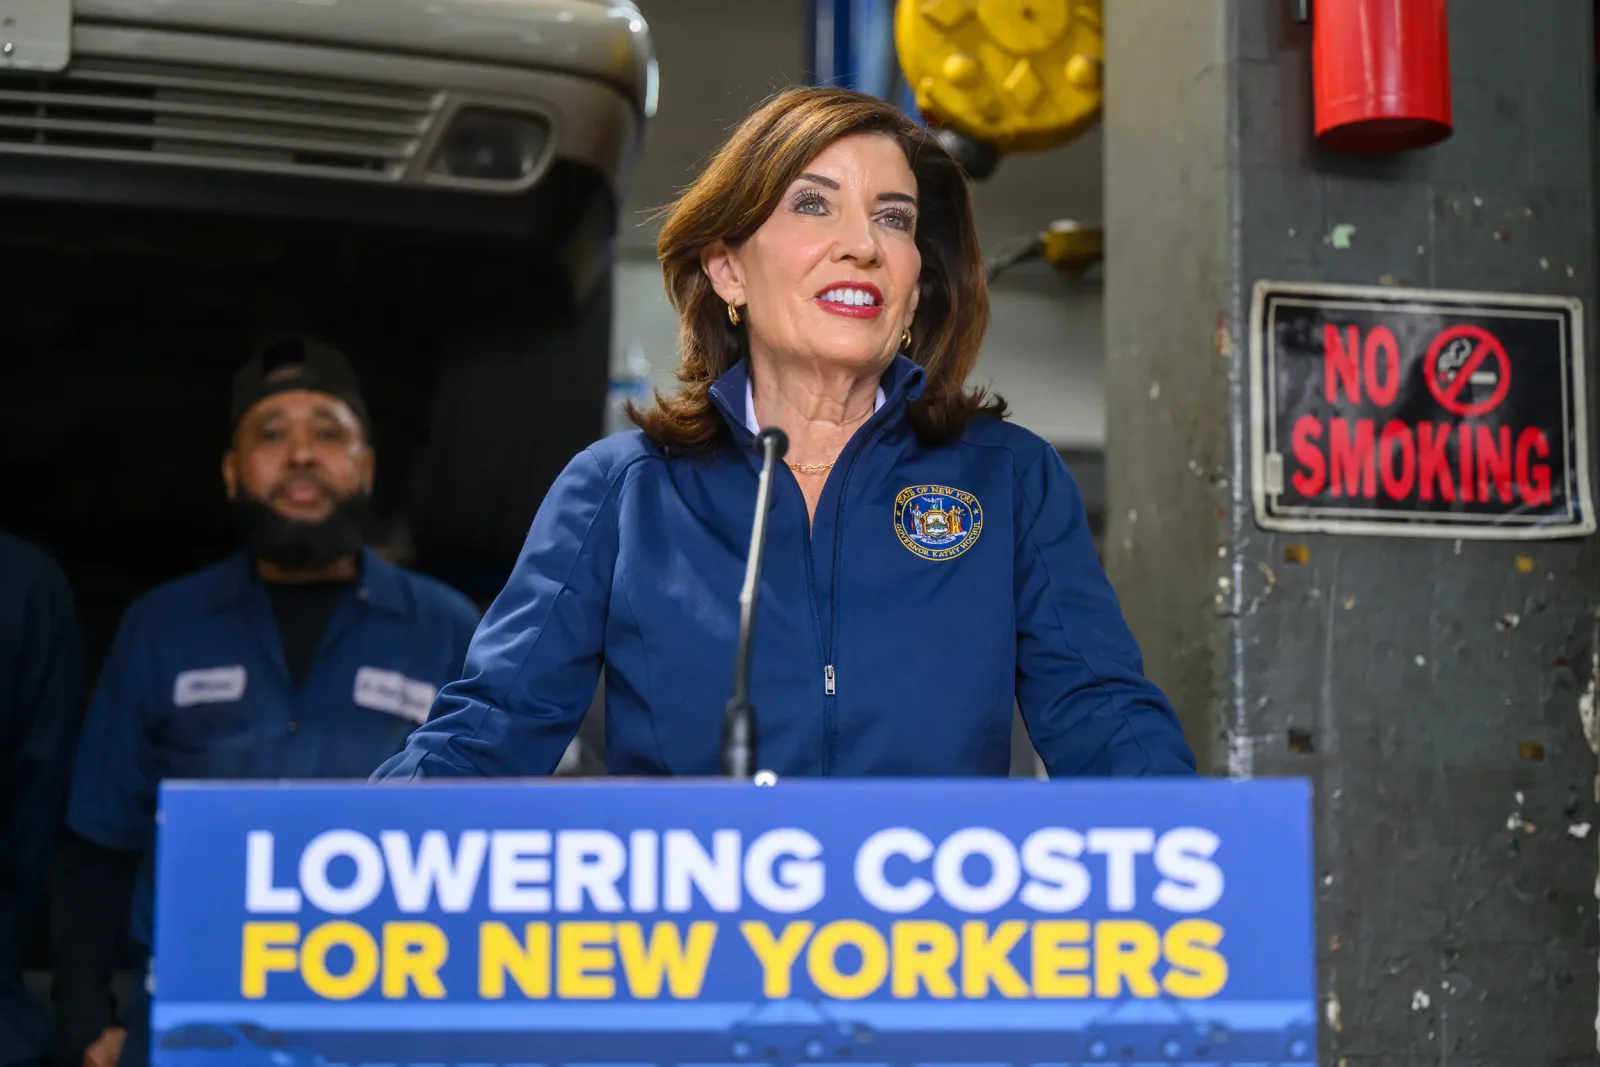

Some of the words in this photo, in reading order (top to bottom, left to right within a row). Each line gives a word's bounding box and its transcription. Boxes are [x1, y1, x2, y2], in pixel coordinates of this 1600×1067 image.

[1323, 323, 1400, 407] NO
[898, 488, 915, 505] STATE
[916, 486, 929, 494] OF
[931, 486, 954, 495] NEW
[956, 491, 975, 505] YORK
[1291, 414, 1552, 506] SMOKING
[896, 523, 930, 556] GOVERNOR
[932, 547, 960, 557] KATHY
[960, 520, 981, 549] HOCHUL
[244, 828, 826, 914] LOWERING
[853, 826, 1225, 914] COSTS
[240, 921, 450, 1000] FOR
[478, 921, 718, 1000] NEW
[739, 918, 1228, 1000] YORKERS
